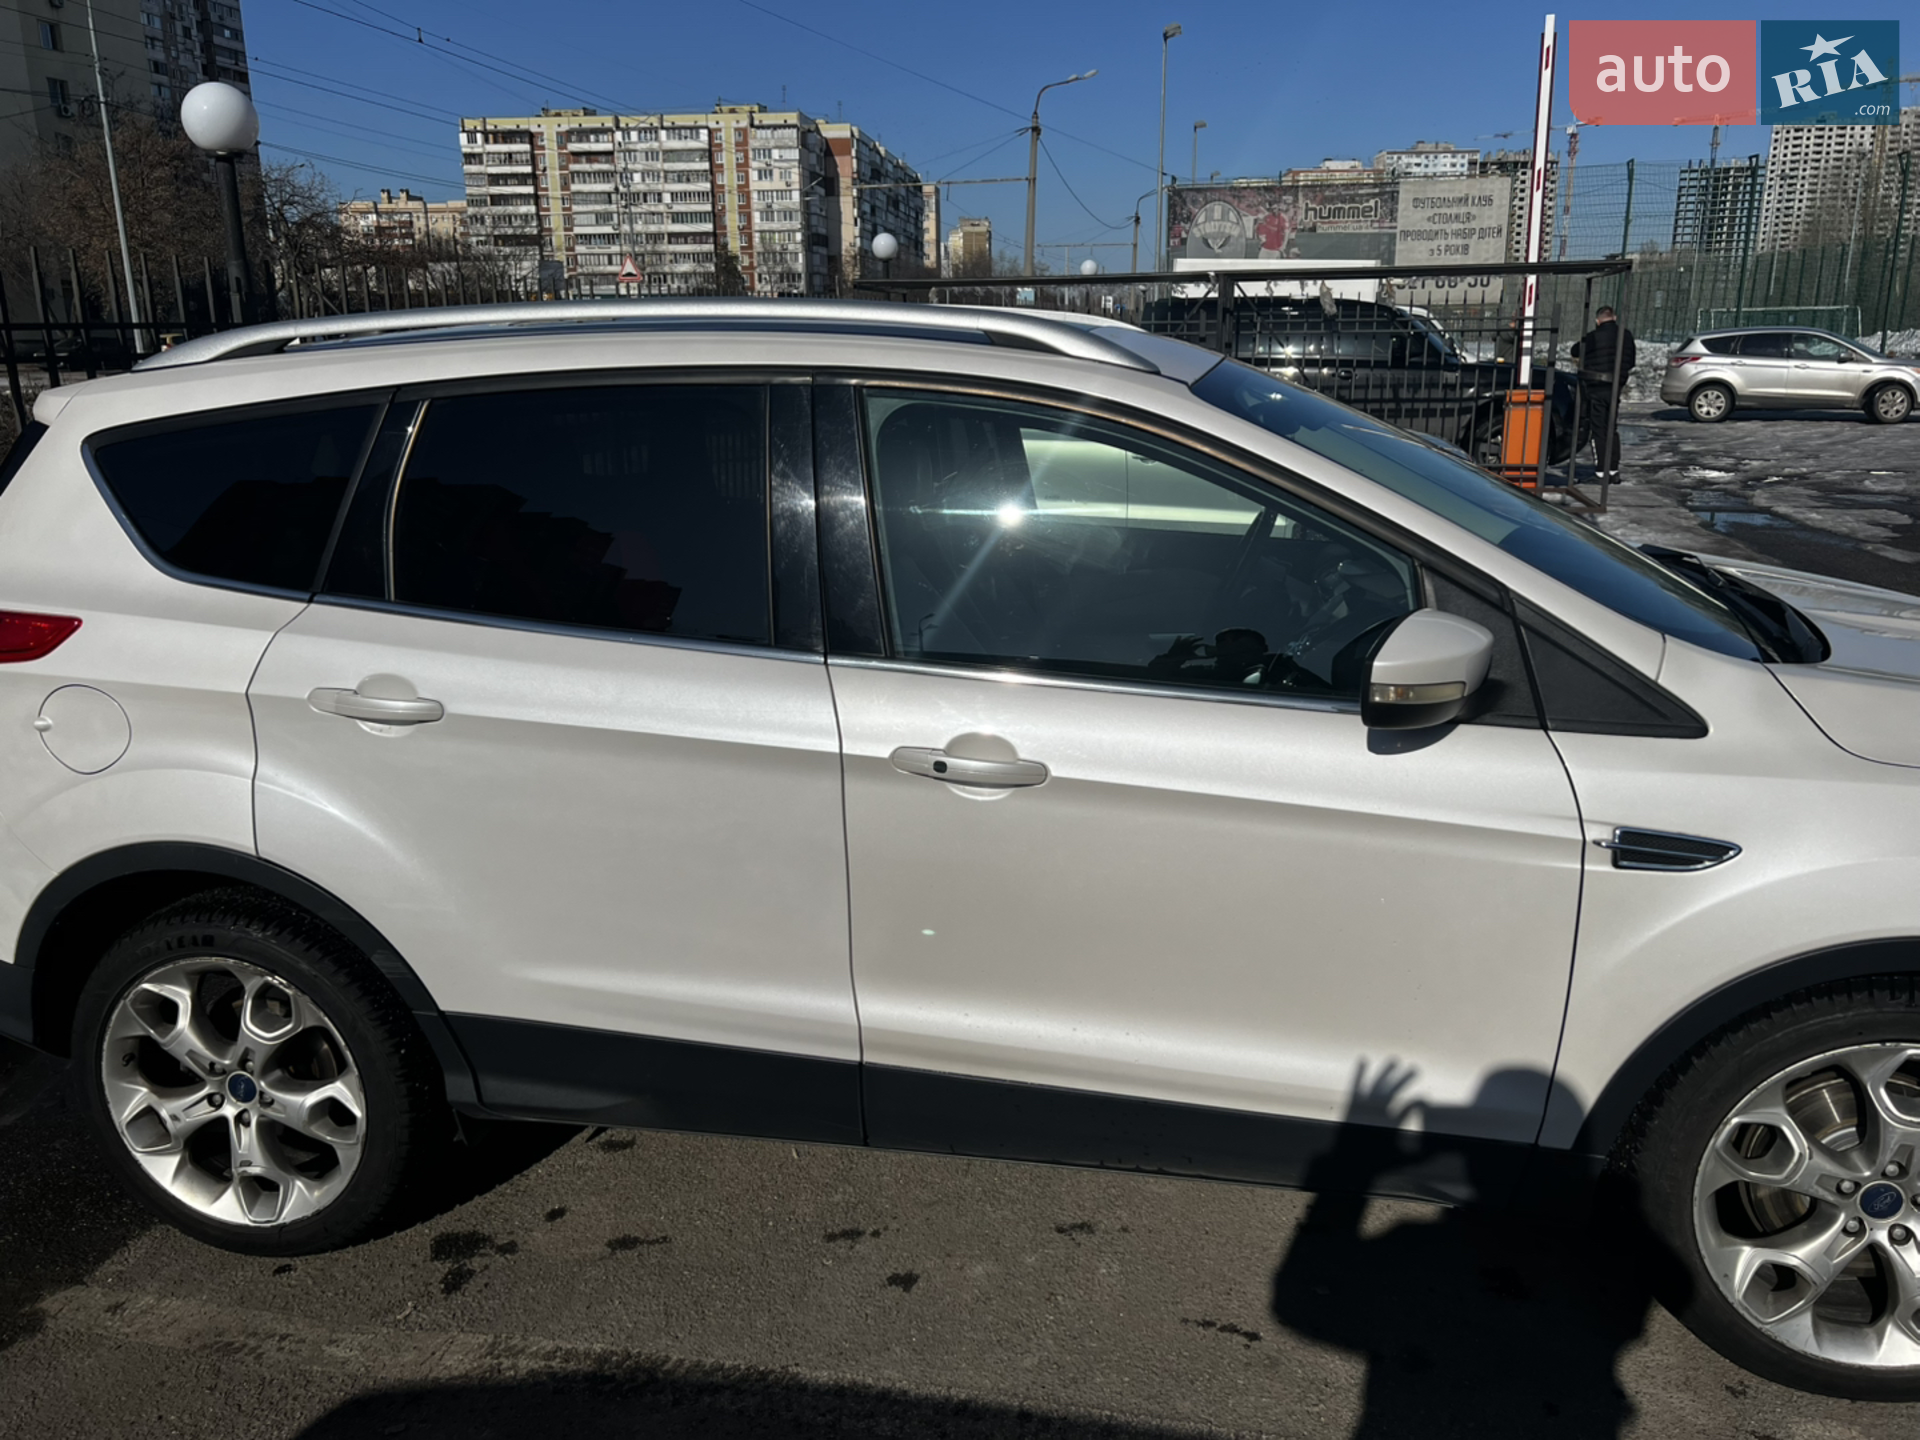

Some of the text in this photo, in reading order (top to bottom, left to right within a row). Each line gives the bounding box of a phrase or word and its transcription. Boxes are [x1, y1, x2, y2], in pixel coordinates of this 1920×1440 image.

[1412, 193, 1494, 209] ФУТБОЛЬНИЙ КЛУБ
[1303, 199, 1379, 221] hummel
[1399, 224, 1503, 242] ПРОВОДИТЬ НАБІР ДІТЕЙ
[1436, 244, 1442, 256] 5
[1444, 244, 1470, 256] РОКІВ
